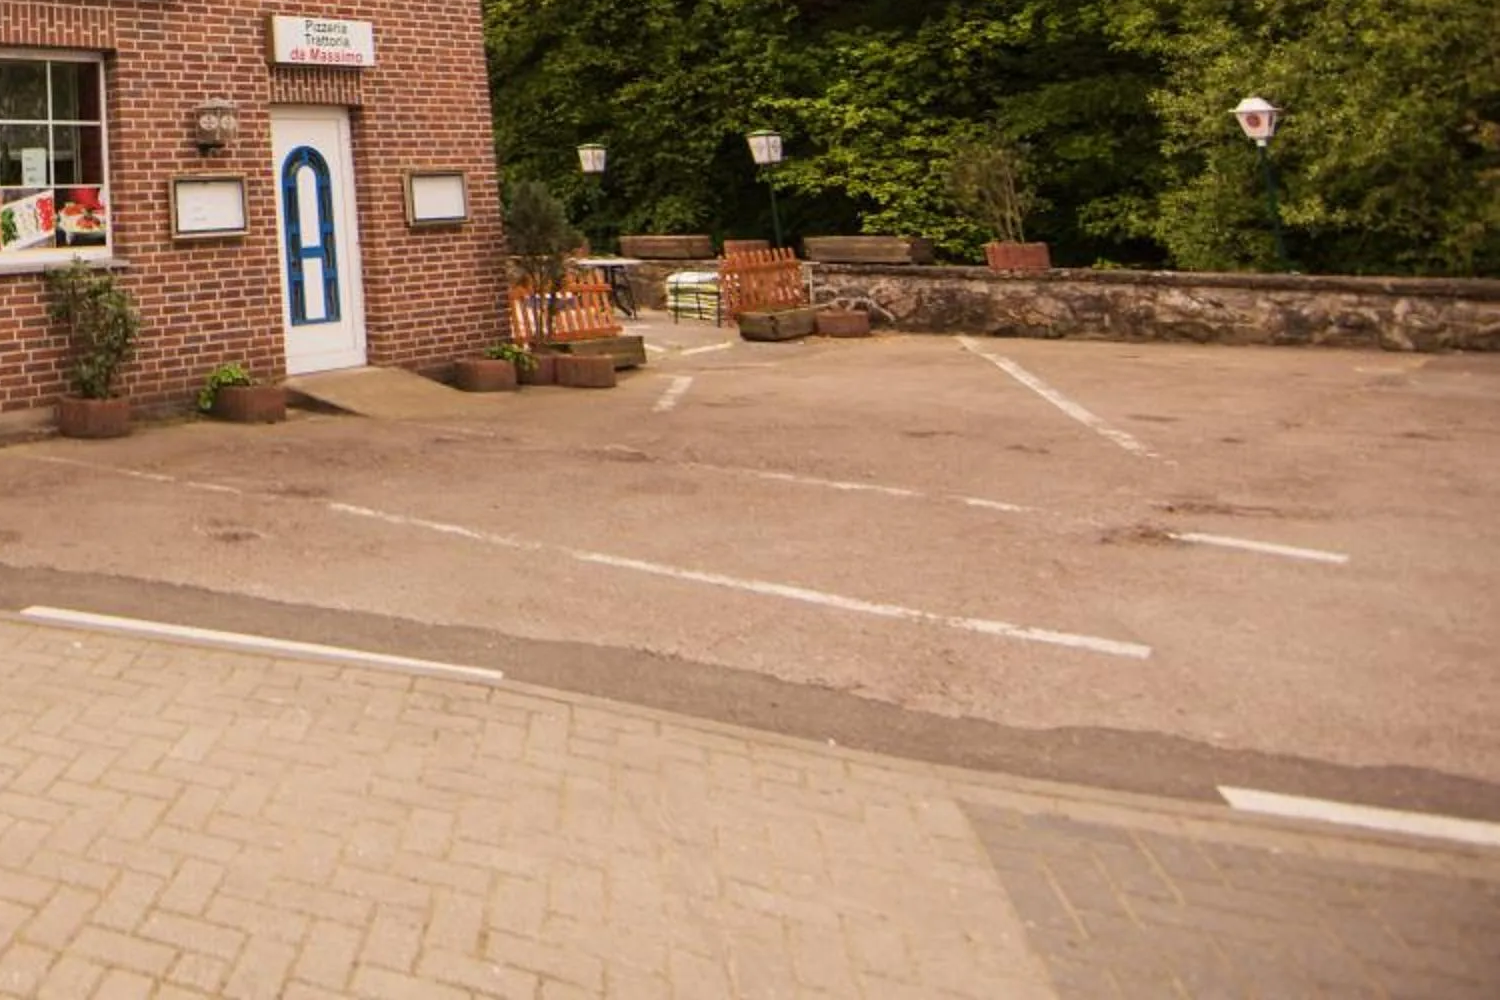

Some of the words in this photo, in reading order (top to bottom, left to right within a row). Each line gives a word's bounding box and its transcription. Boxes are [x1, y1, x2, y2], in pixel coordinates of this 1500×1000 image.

[305, 20, 347, 34] Pizzeria
[305, 33, 350, 47] Trattoria
[291, 46, 305, 60] da
[310, 48, 363, 63] Massimo
